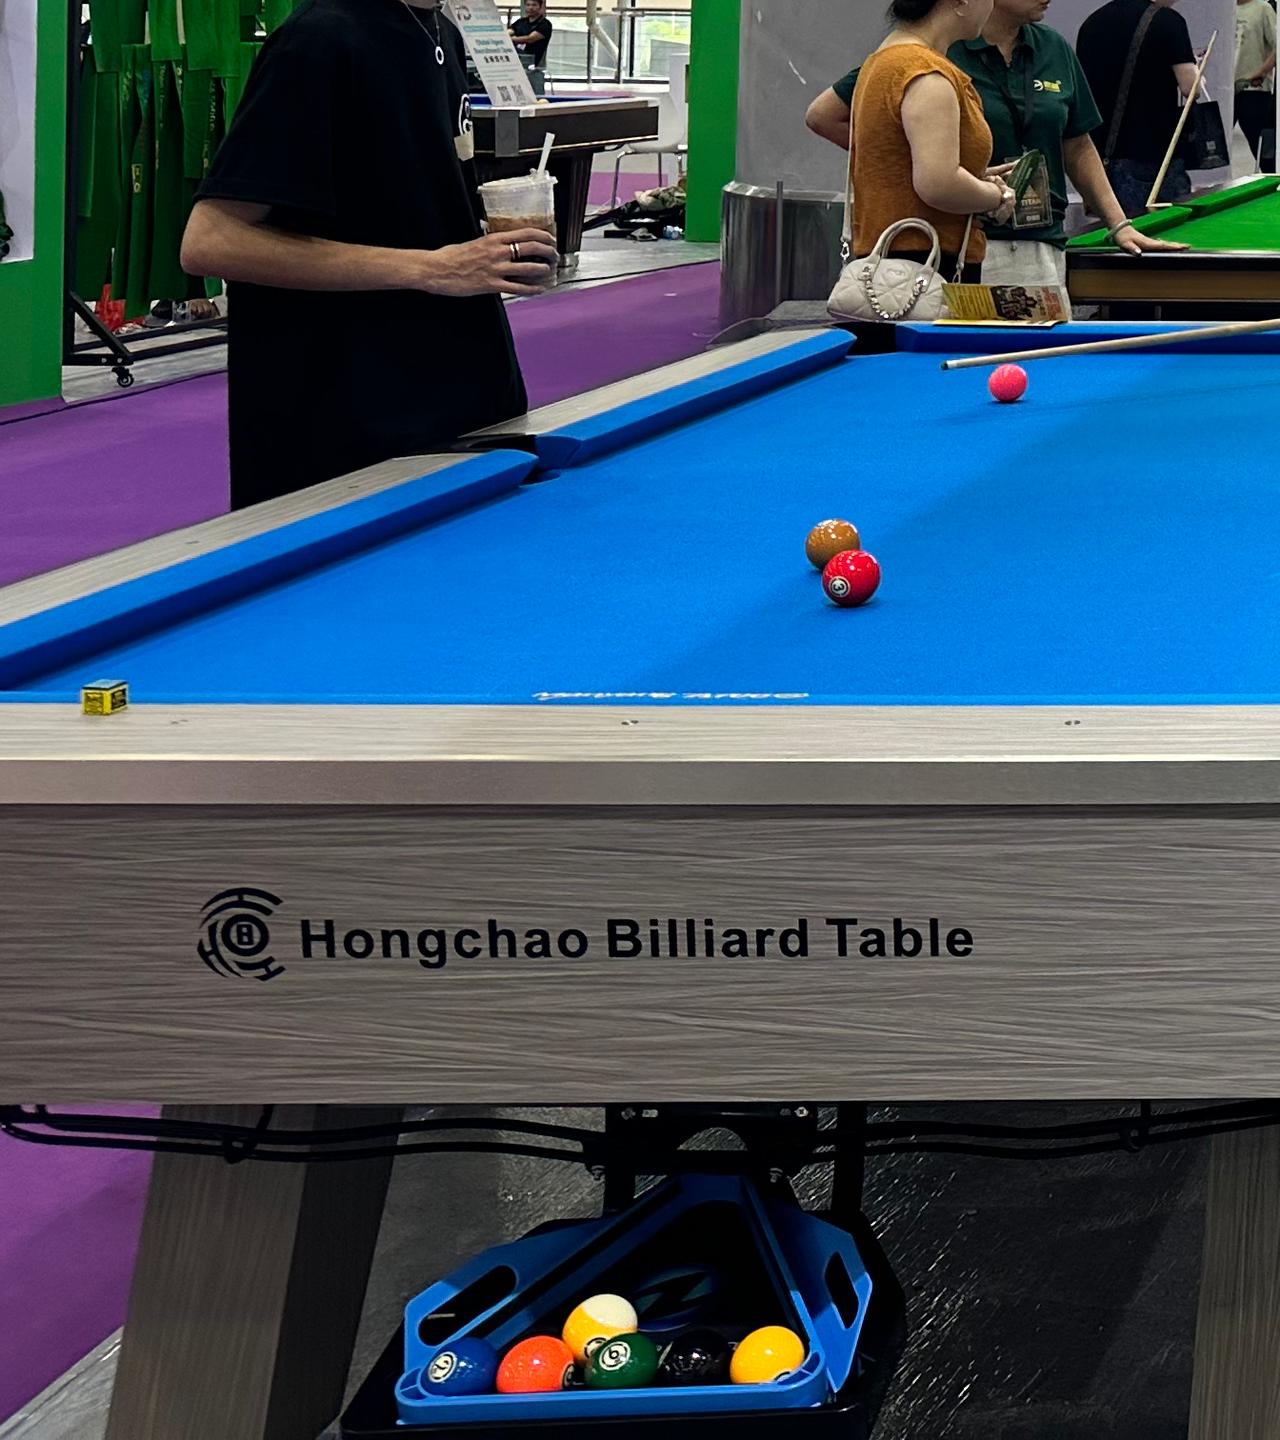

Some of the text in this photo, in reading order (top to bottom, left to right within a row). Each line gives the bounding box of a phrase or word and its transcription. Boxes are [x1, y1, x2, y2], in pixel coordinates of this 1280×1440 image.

[300, 917, 974, 969] Hongchao Billiard Table
